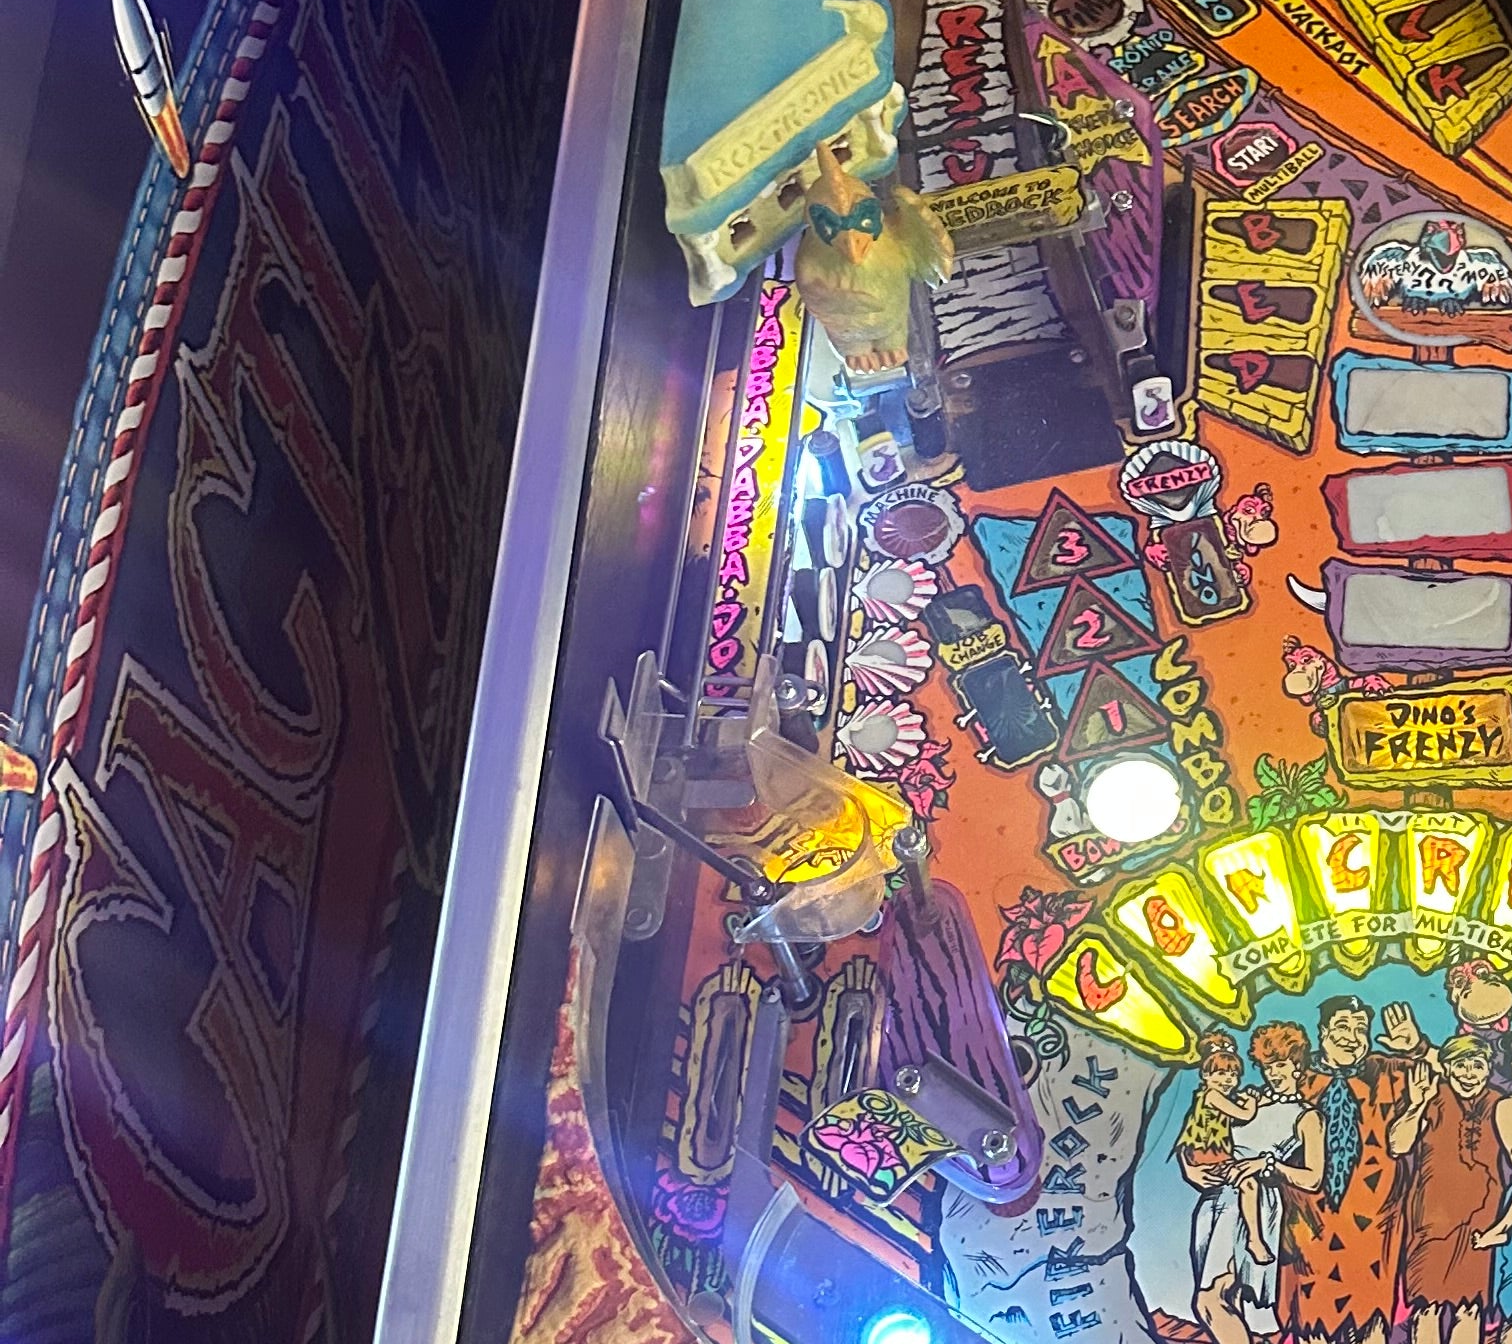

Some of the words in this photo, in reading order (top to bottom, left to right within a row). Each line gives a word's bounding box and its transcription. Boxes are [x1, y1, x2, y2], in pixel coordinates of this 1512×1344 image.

[1285, 2, 1372, 75] JACKPOT
[1158, 79, 1243, 139] SEARCH
[1226, 134, 1281, 172] START
[1248, 146, 1321, 201] MULTIBALL
[929, 183, 1021, 214] WELCOME
[1024, 178, 1052, 194] TO
[1365, 256, 1421, 280] MYSTERY
[1462, 265, 1506, 284] MODE
[1128, 464, 1213, 496] FRENZY
[867, 487, 941, 524] MACHINE
[1054, 527, 1089, 565] 3
[1072, 609, 1110, 649] 2
[949, 635, 1005, 666] CHANGE
[1100, 700, 1123, 735] 1
[1151, 638, 1234, 826] COMBO
[1385, 702, 1477, 727] DINO'S
[1364, 727, 1504, 765] FRENZY
[1353, 914, 1397, 936] FOR
